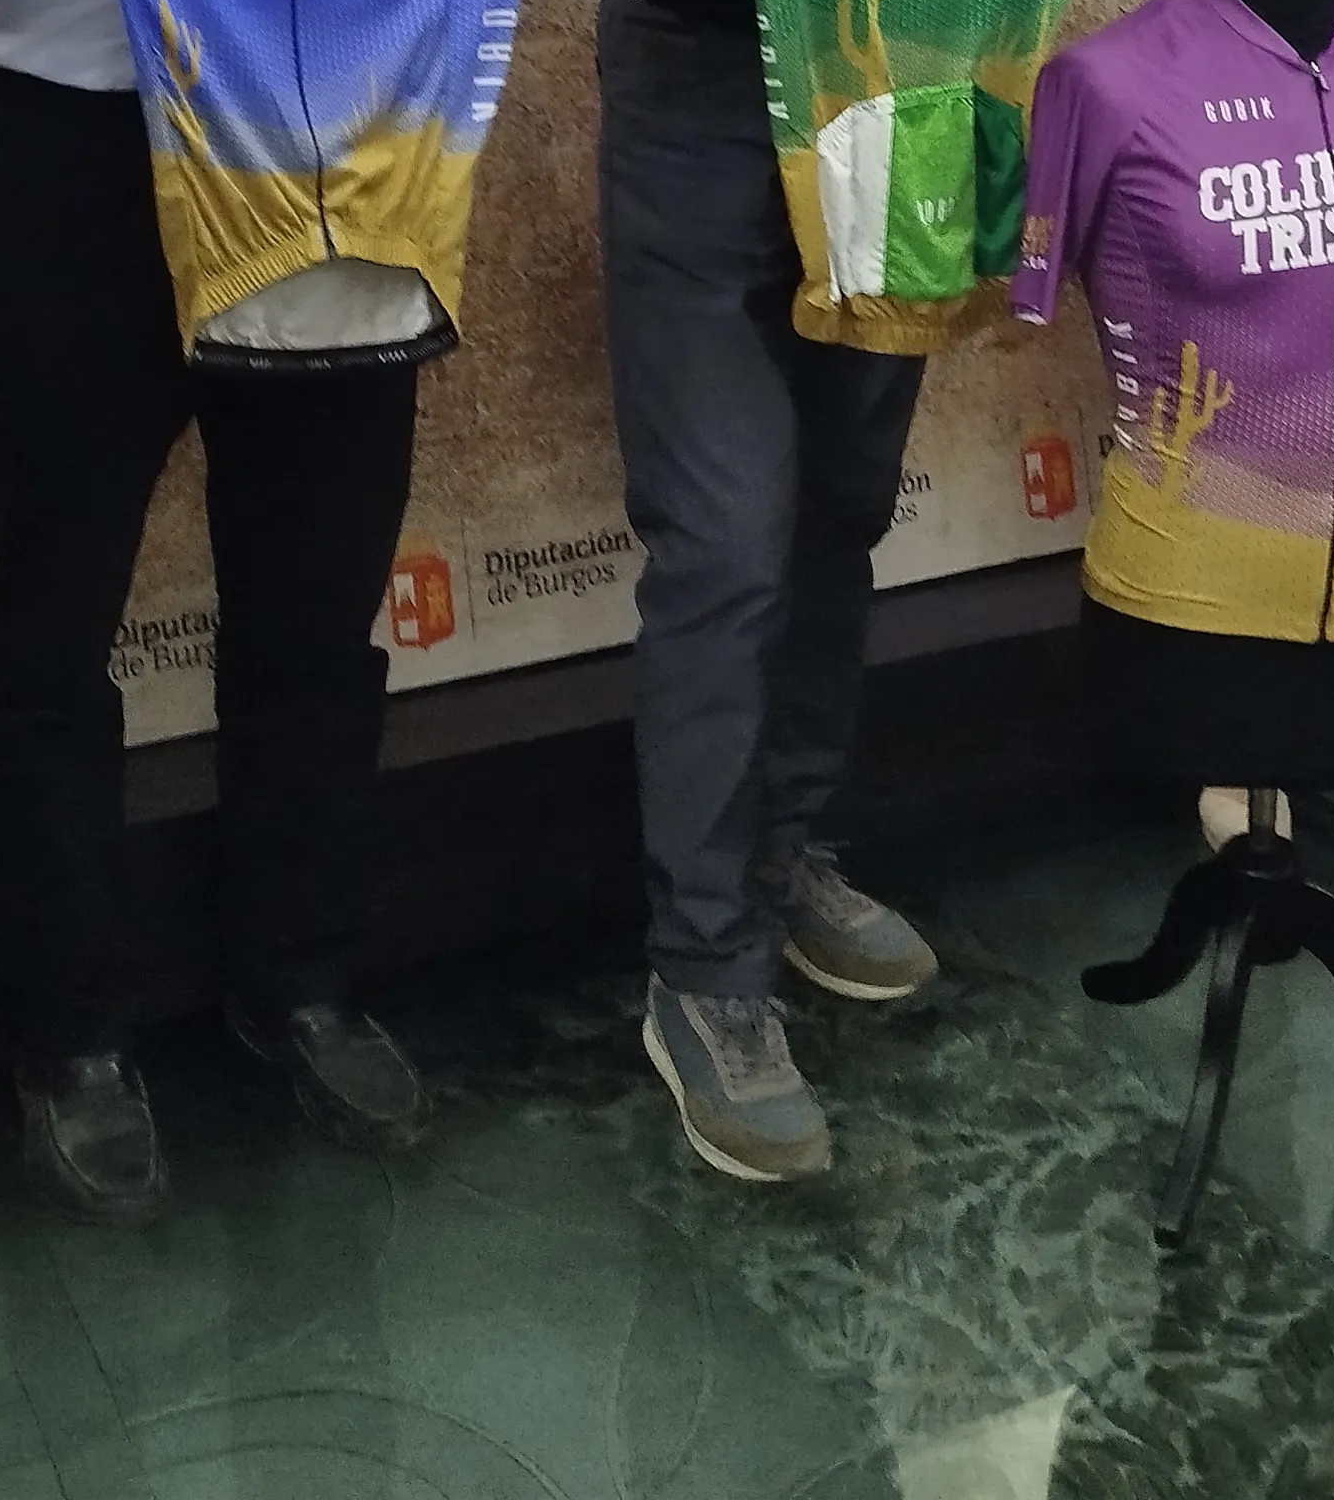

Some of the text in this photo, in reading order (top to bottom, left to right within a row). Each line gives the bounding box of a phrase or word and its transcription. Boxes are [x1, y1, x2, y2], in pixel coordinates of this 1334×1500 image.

[1203, 96, 1275, 123] GOBIK
[483, 528, 633, 581] Diputación
[487, 562, 616, 606] de Burgos
